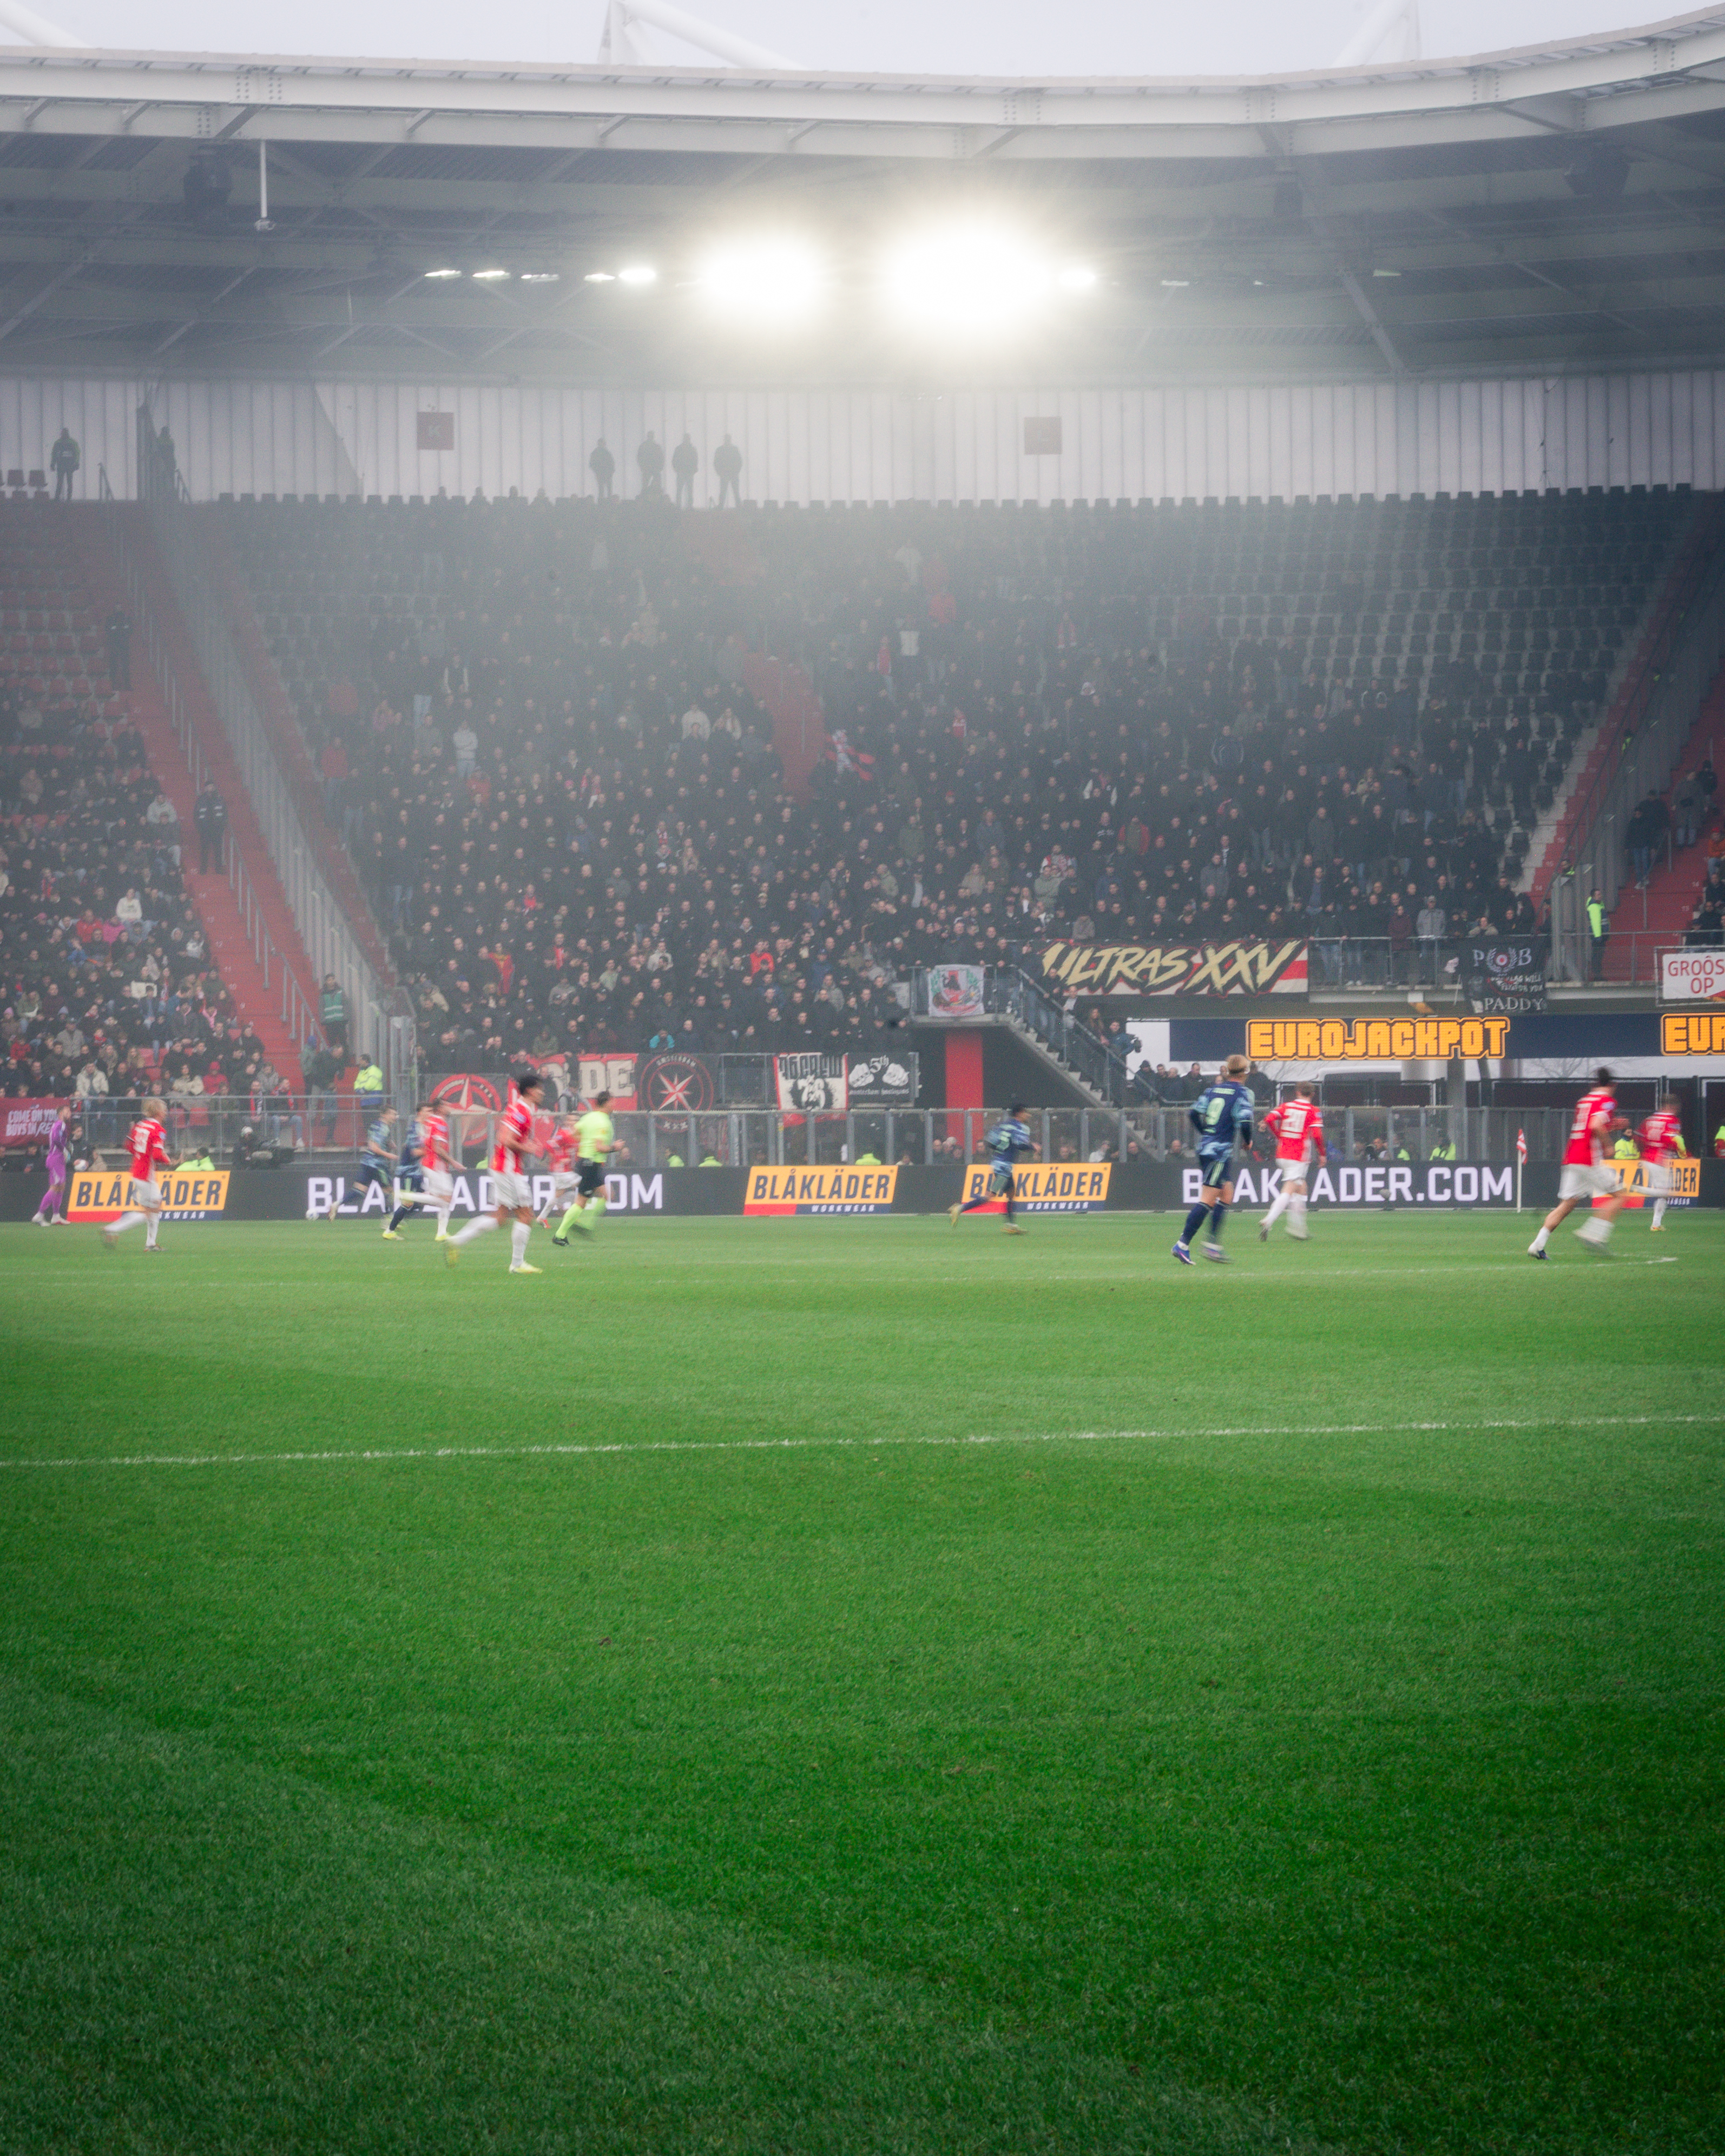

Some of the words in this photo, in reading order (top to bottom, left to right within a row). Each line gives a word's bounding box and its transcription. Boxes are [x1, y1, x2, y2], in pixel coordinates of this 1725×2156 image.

[1042, 942, 1188, 986] ULTRAS
[1183, 940, 1301, 994] XXV
[1668, 955, 1725, 977] GROÔS
[1691, 978, 1714, 994] OP
[1484, 997, 1543, 1011] PADDY
[1249, 1021, 1507, 1058] EUROJACKPOT
[1206, 1097, 1225, 1125] 9
[35, 1122, 53, 1137] RE
[75, 1174, 222, 1207] BLÅÄDER
[753, 1169, 890, 1199] BLÅKLÄDER
[970, 1166, 1104, 1199] BKLÄDER
[1183, 1167, 1512, 1203] BAKADER.COM
[811, 1204, 874, 1213] WORKWEAR
[1028, 1202, 1089, 1210] WORKWEAR
